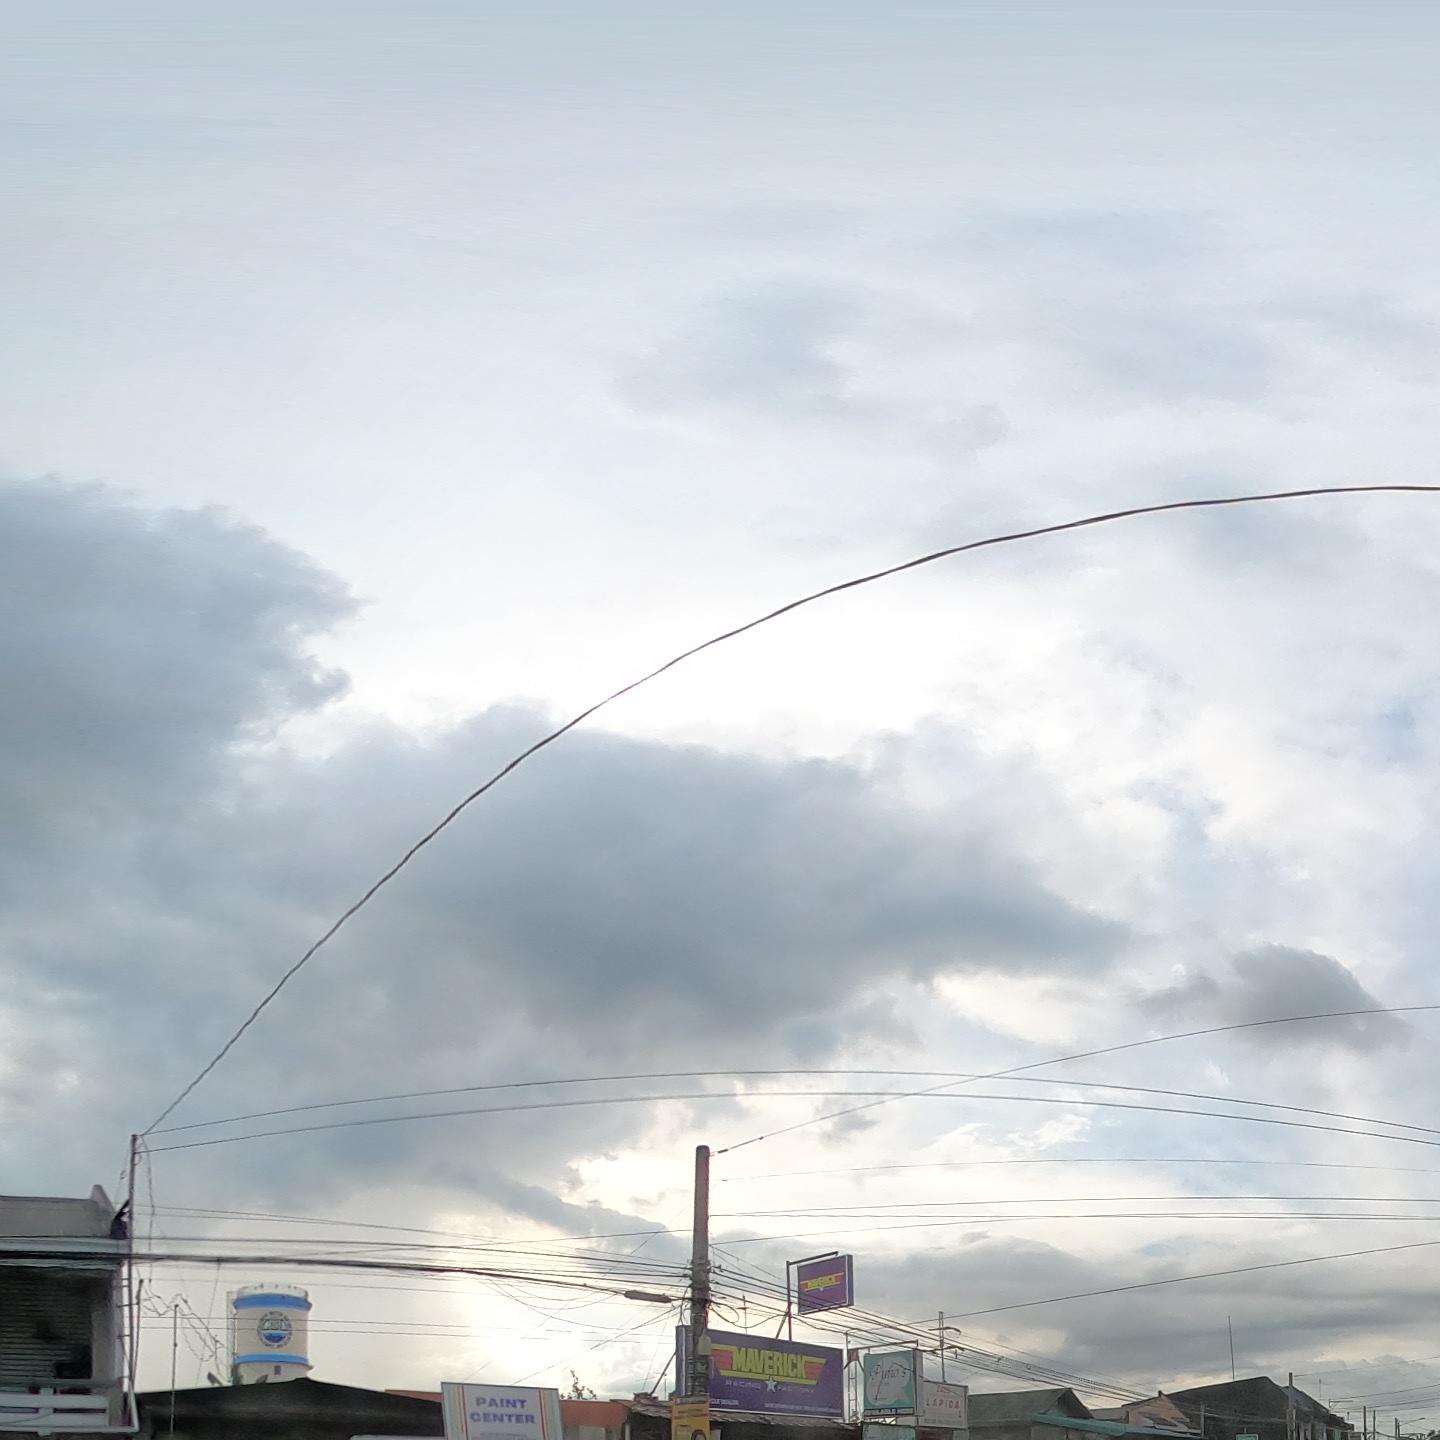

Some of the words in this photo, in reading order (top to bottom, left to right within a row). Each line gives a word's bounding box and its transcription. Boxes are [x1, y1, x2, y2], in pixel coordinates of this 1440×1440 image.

[733, 1347, 806, 1378] MAVERICK
[476, 1397, 528, 1409] PAINT
[470, 1412, 536, 1425] CENTER
